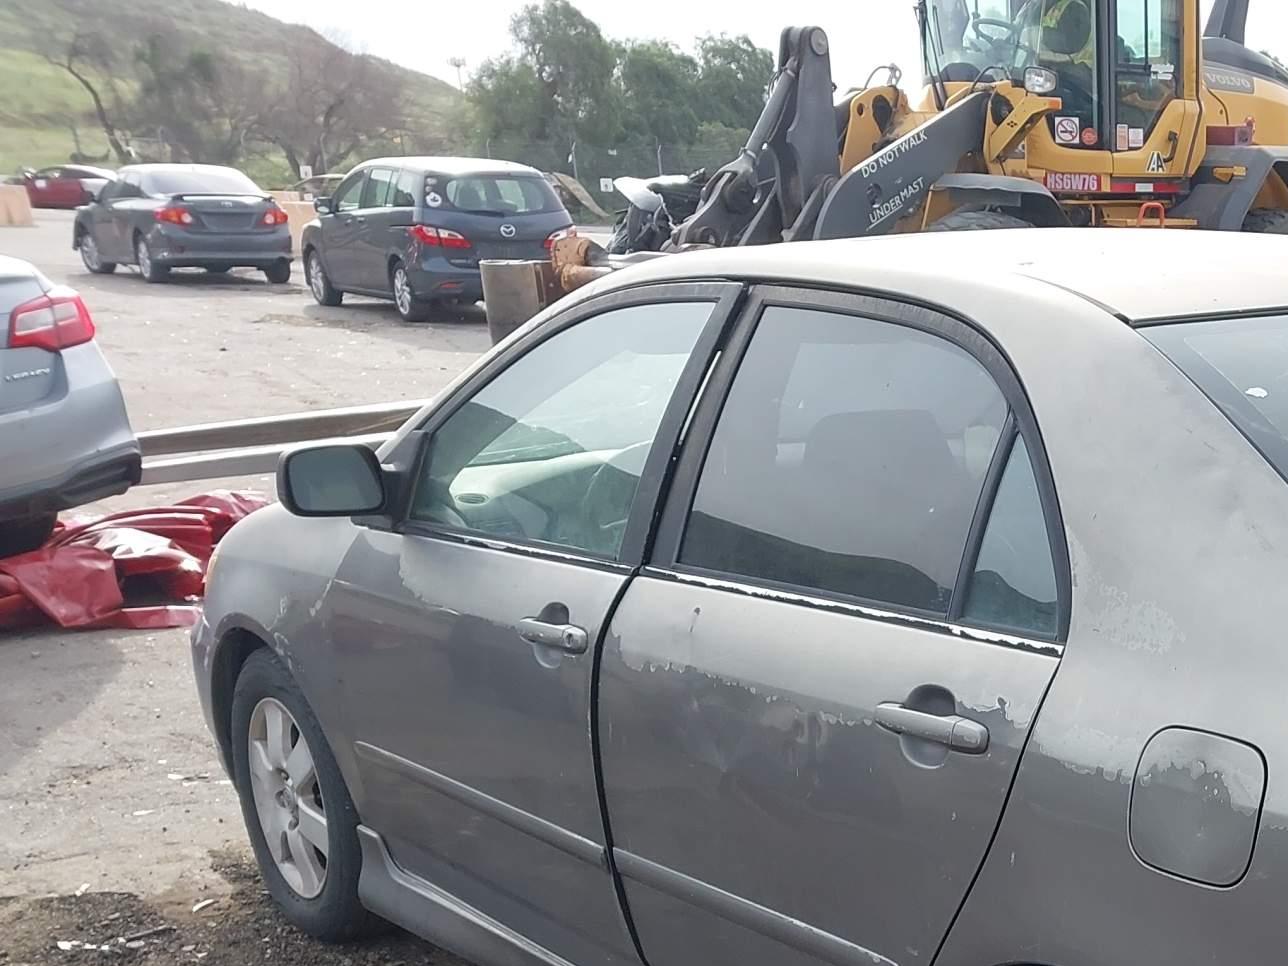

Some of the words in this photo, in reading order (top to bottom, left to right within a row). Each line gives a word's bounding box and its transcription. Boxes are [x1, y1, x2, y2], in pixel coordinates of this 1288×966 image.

[1205, 72, 1250, 88] VOLVO
[861, 162, 877, 178] DO
[879, 145, 900, 168] NOT
[899, 129, 928, 153] WALK
[868, 196, 902, 223] UNDER
[900, 177, 924, 201] MAST
